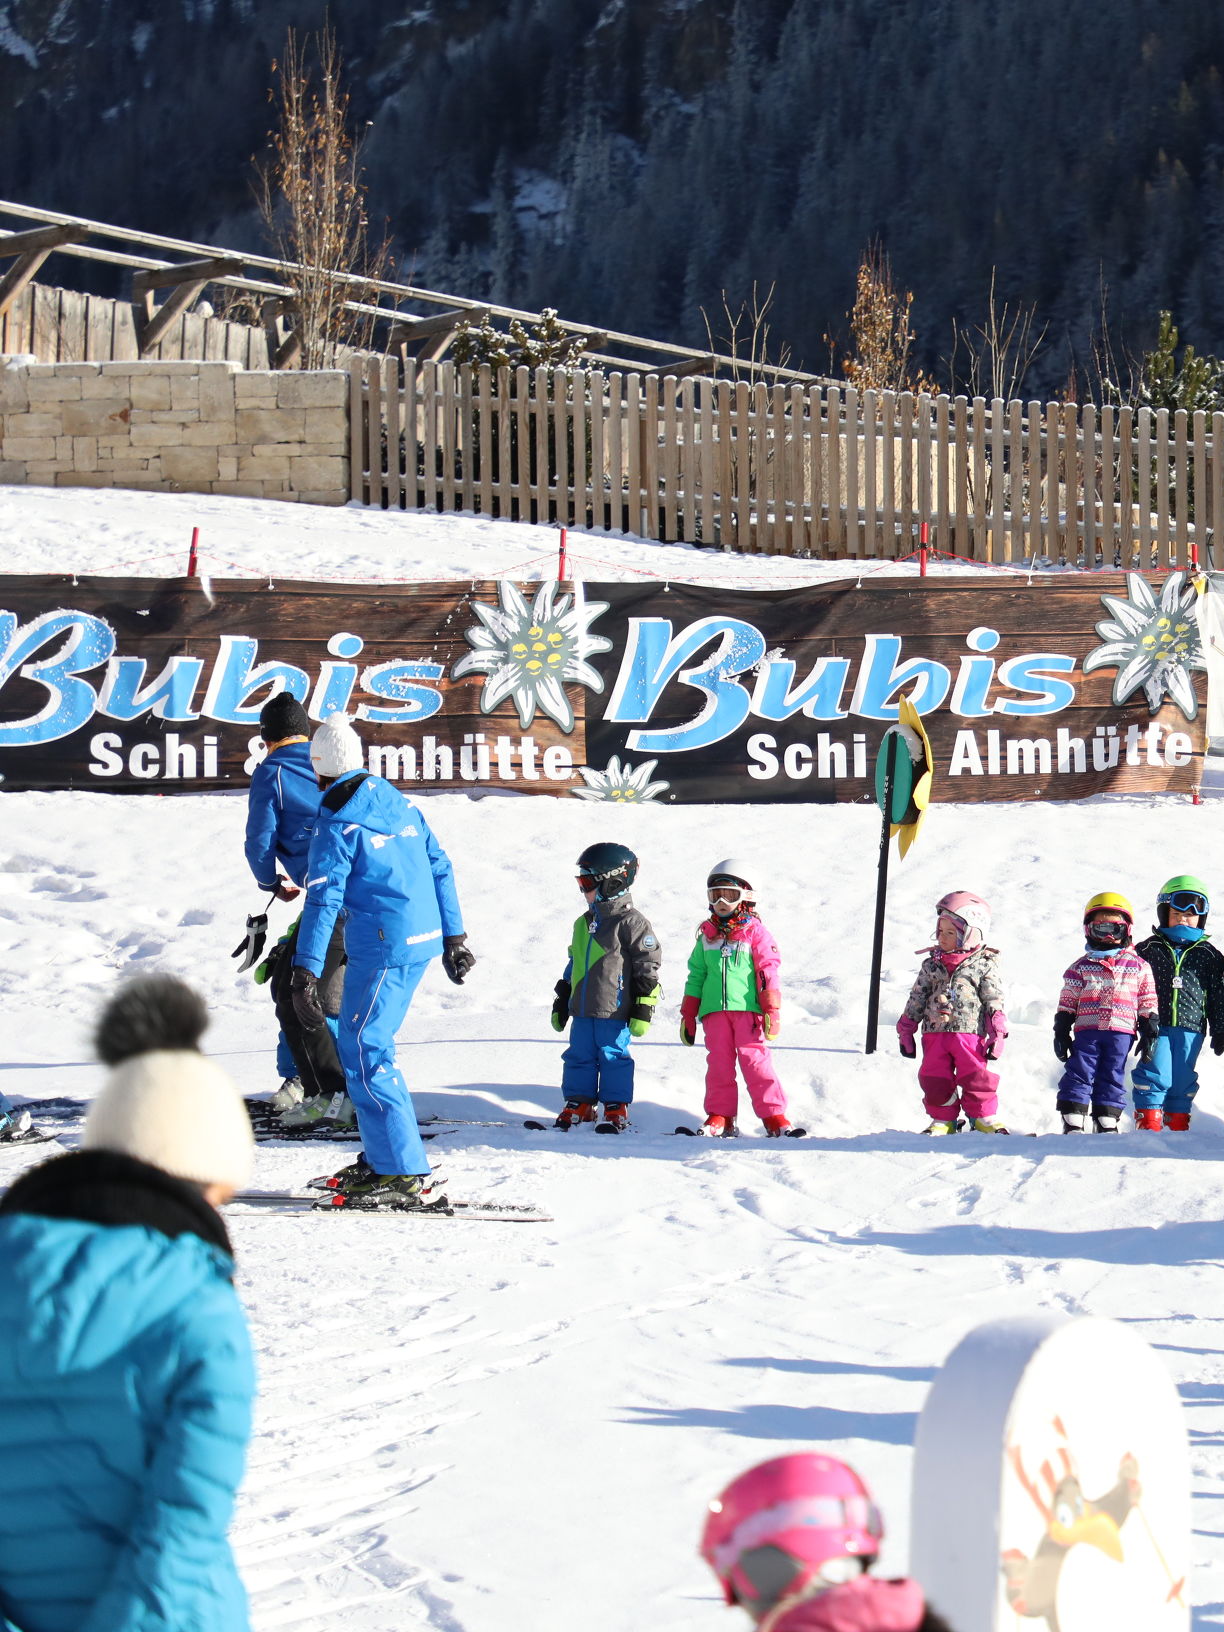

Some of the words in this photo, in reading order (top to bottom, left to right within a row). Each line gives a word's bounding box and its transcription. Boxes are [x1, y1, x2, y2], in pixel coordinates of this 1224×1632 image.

[0, 608, 445, 747] Bubis
[602, 615, 1077, 753] Bubis
[88, 732, 218, 779] Schi
[368, 733, 573, 781] mhütte
[746, 733, 867, 780] Schi
[948, 722, 1193, 776] Almhütte
[594, 865, 627, 882] uvex
